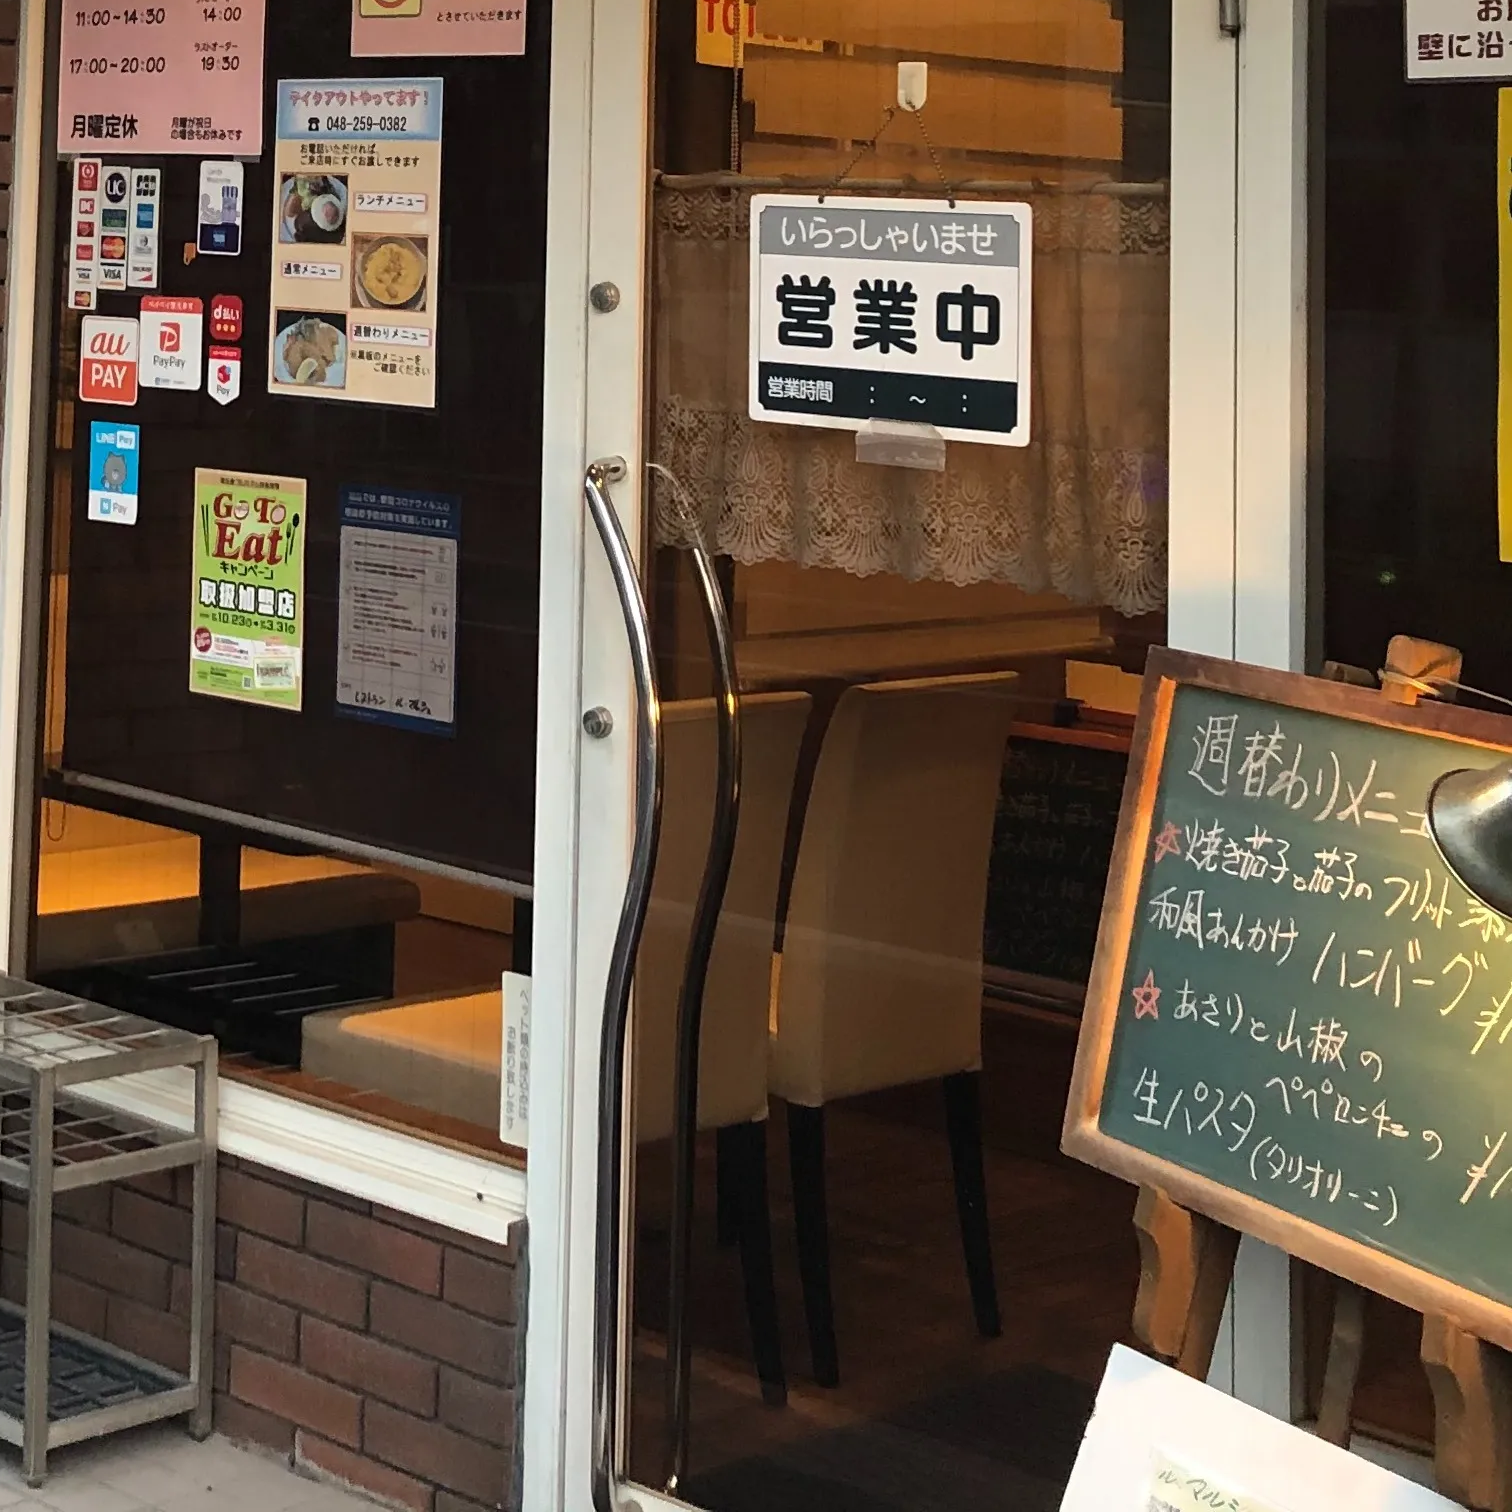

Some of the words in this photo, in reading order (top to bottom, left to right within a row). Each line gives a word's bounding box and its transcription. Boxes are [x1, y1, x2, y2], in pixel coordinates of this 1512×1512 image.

[202, 6, 242, 22] 14:00
[436, 9, 522, 22] とさせていただきます
[1417, 31, 1512, 61] 壁に沿
[201, 55, 240, 71] 19:30
[71, 114, 139, 138] 月曜定休
[326, 116, 407, 131] 048-259-0382
[357, 194, 424, 206] ランチメニュー
[781, 216, 997, 256] いらっしゃいませ
[103, 268, 122, 280] VISA
[776, 274, 1000, 360] 営業中
[90, 332, 130, 356] au
[153, 355, 186, 370] PayPay
[91, 363, 127, 388] PAY
[768, 375, 833, 404] 営業時間
[213, 492, 249, 520] Go
[254, 496, 286, 525] To
[212, 519, 283, 565] Eat
[220, 561, 274, 580] キャンペーン
